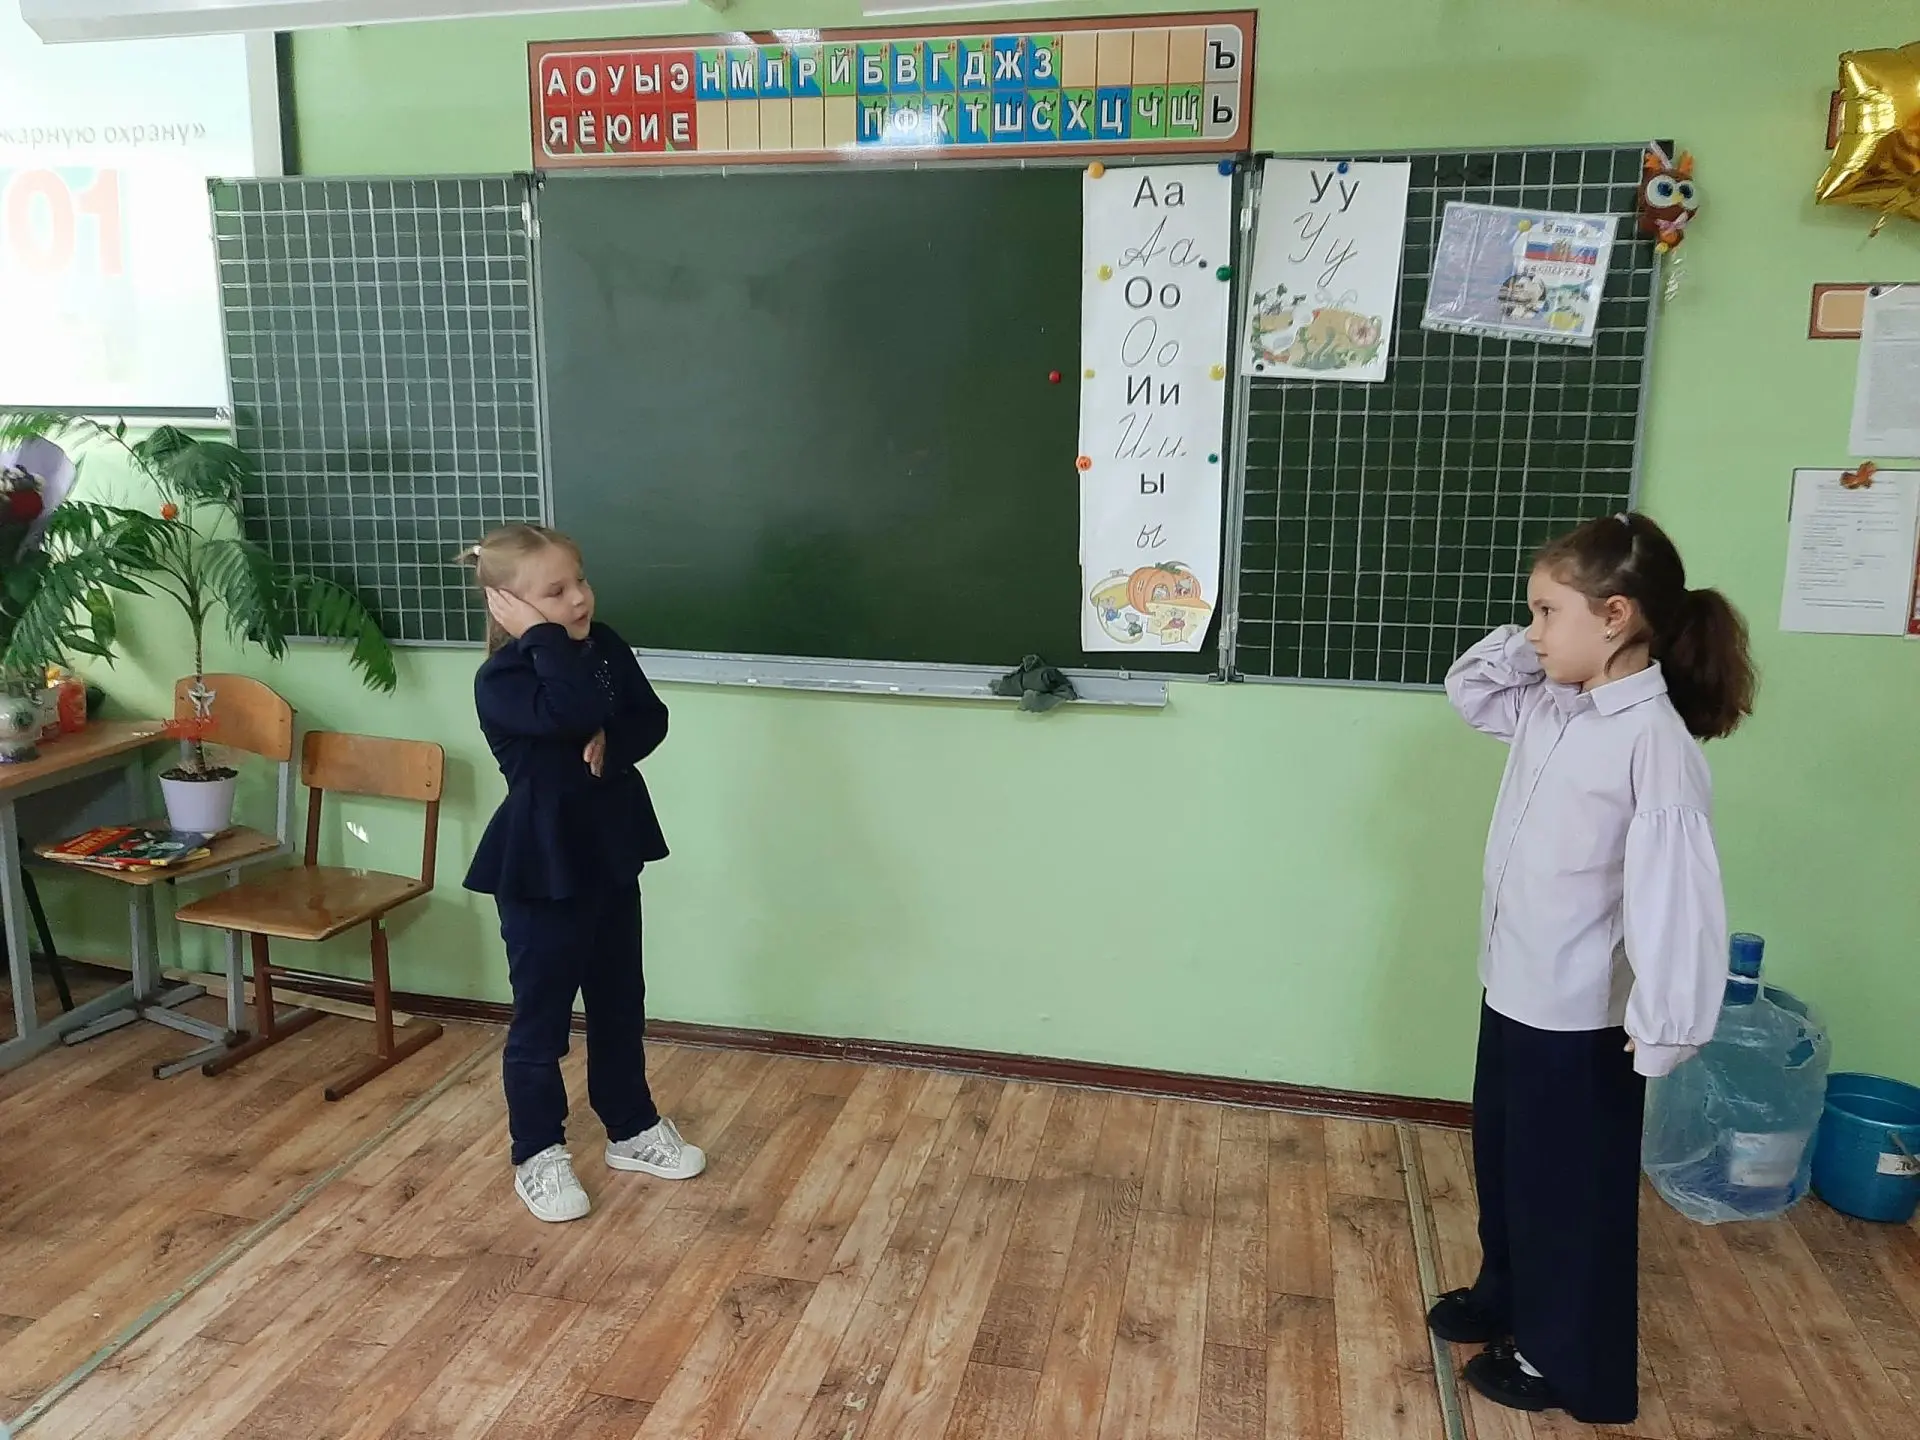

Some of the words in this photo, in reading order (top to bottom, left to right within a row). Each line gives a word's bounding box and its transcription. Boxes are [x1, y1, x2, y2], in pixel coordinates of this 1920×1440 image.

[547, 68, 567, 96] А
[576, 66, 597, 96] О
[607, 65, 625, 95] У
[635, 64, 660, 94] Ы
[670, 62, 689, 93] Э
[701, 61, 720, 90] Н
[732, 60, 754, 90] М
[764, 58, 784, 89] Л
[799, 58, 817, 88] Р
[830, 48, 850, 85] Й
[863, 55, 883, 84] Б
[896, 54, 916, 84] В
[932, 52, 950, 83] Г
[963, 51, 986, 87] Д
[994, 50, 1022, 80] Ж
[1034, 48, 1052, 78] З
[1209, 40, 1236, 69] Ъ
[104, 121, 206, 147] охрану»
[549, 116, 568, 146] Я
[579, 110, 596, 144] Ё
[606, 114, 632, 144] Ю
[640, 113, 658, 143] И
[672, 112, 690, 143] Е
[864, 107, 883, 137] П
[894, 106, 919, 135] Ф
[932, 104, 950, 135] К
[966, 104, 984, 133] Т
[994, 103, 1022, 132] Ш
[1031, 101, 1052, 130] С
[1067, 100, 1088, 130] Х
[1102, 99, 1122, 134] Ц
[1138, 97, 1158, 127] Ч
[1171, 96, 1198, 132] Щ
[1212, 96, 1233, 123] Ь
[1132, 174, 1185, 208] Аа
[1309, 169, 1361, 213] Уу
[7, 168, 124, 276] 01
[1124, 275, 1182, 309] Оо
[1126, 374, 1182, 407] Ии
[1139, 473, 1165, 495] ы
